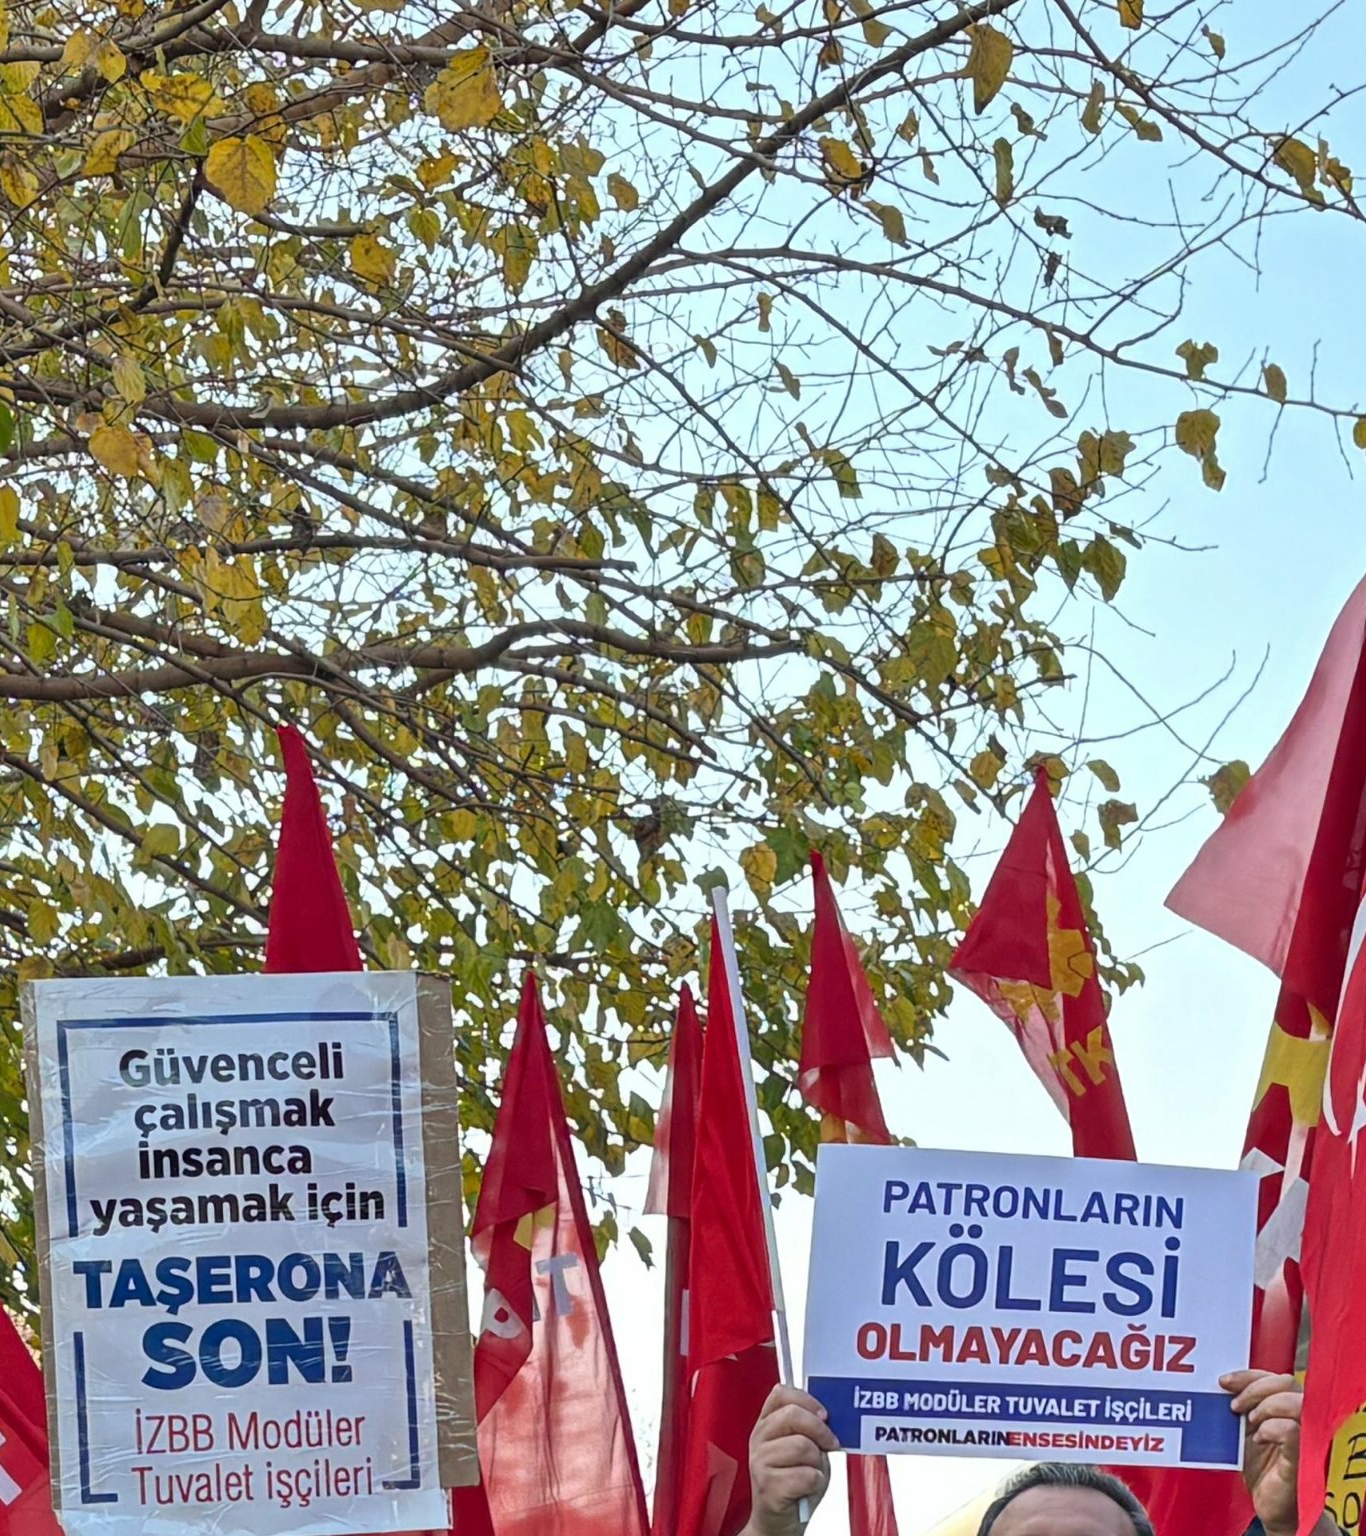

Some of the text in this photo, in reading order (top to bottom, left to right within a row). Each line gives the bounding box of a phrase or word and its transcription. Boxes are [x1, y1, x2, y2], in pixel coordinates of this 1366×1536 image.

[118, 1042, 345, 1087] Güvenceli
[134, 1089, 335, 1139] çalışmak
[137, 1141, 312, 1180] insanca
[89, 1182, 385, 1236] yaşamak için
[882, 1180, 1184, 1230] PATRONLARIN
[73, 1250, 412, 1316] TAŞERONA
[881, 1223, 1181, 1319] KÖLESİ
[141, 1316, 353, 1391] SON!
[856, 1322, 1197, 1373] OLMAYACAĞIZ
[853, 1385, 1192, 1424] İZBB MODÜLER TUVALET İŞÇİLERİ
[135, 1407, 365, 1455] İZBB Modüler
[131, 1457, 373, 1510] Tuvalet işçileri
